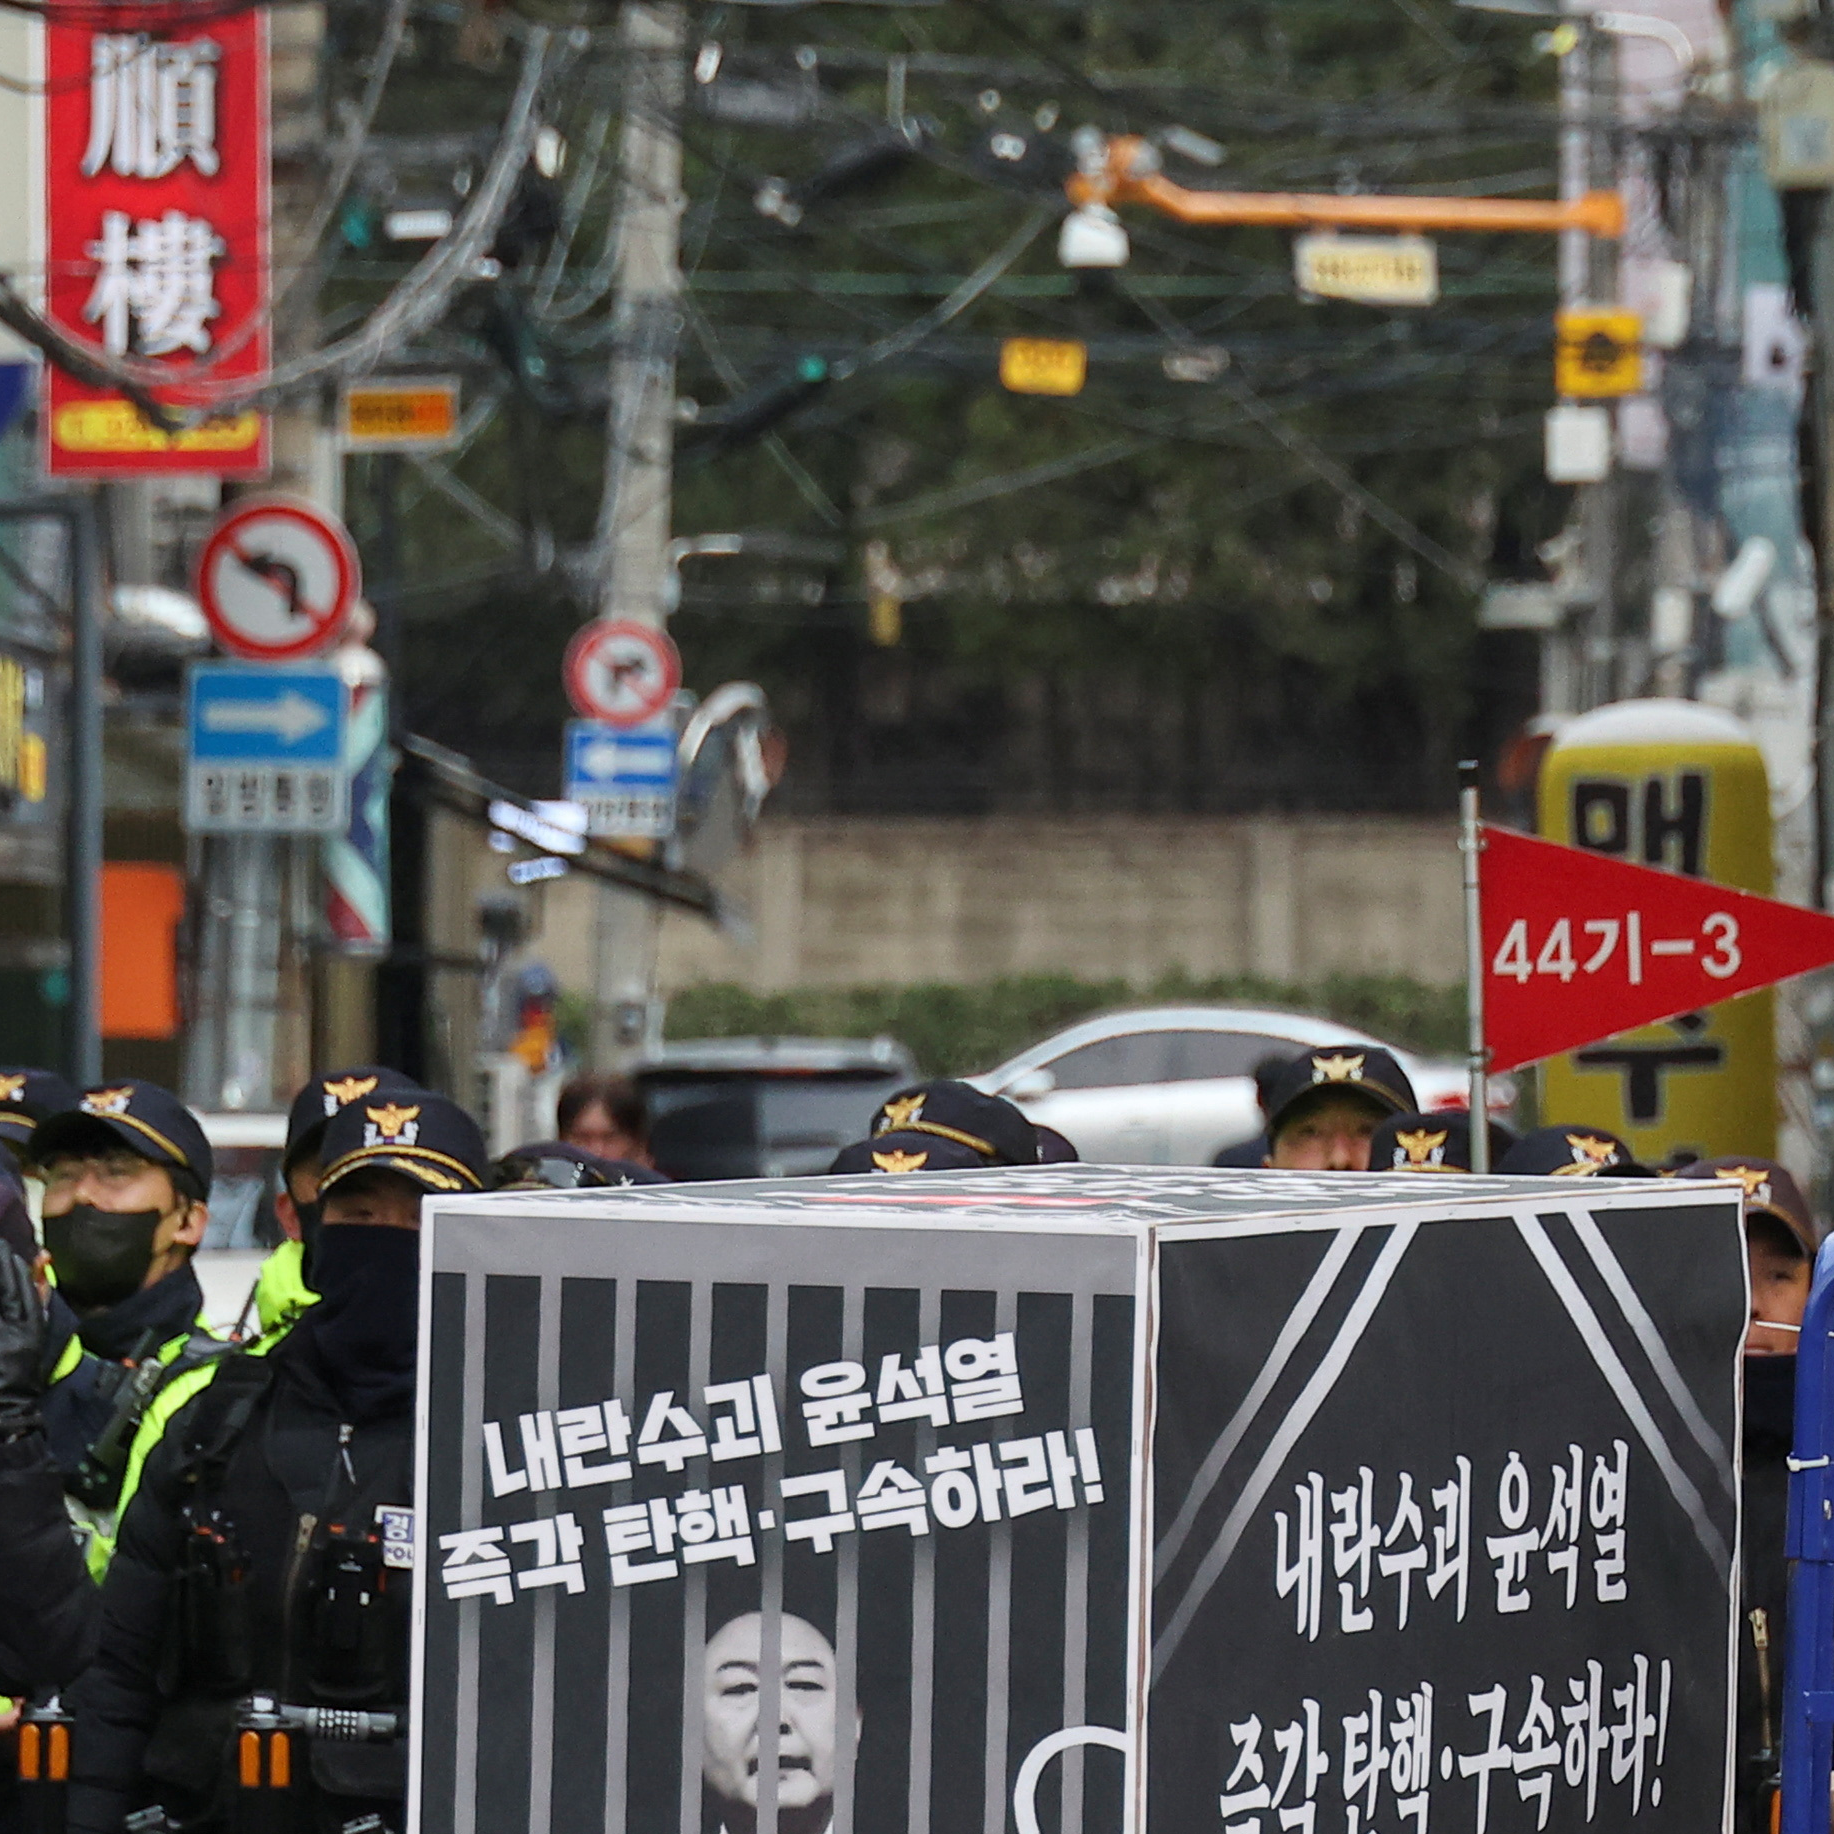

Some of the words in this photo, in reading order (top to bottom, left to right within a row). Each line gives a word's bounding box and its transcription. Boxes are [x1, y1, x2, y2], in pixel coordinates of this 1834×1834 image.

[1492, 910, 1743, 986] 44기-3
[481, 1371, 784, 1500] 내란수괴
[799, 1329, 1026, 1449] 윤석열
[385, 1513, 410, 1541] 경
[438, 1511, 587, 1606] 즉각
[601, 1427, 1106, 1589] 탄핵·구속하라!
[1273, 1454, 1472, 1643] 내란수괴
[1485, 1438, 1631, 1615] 윤석열
